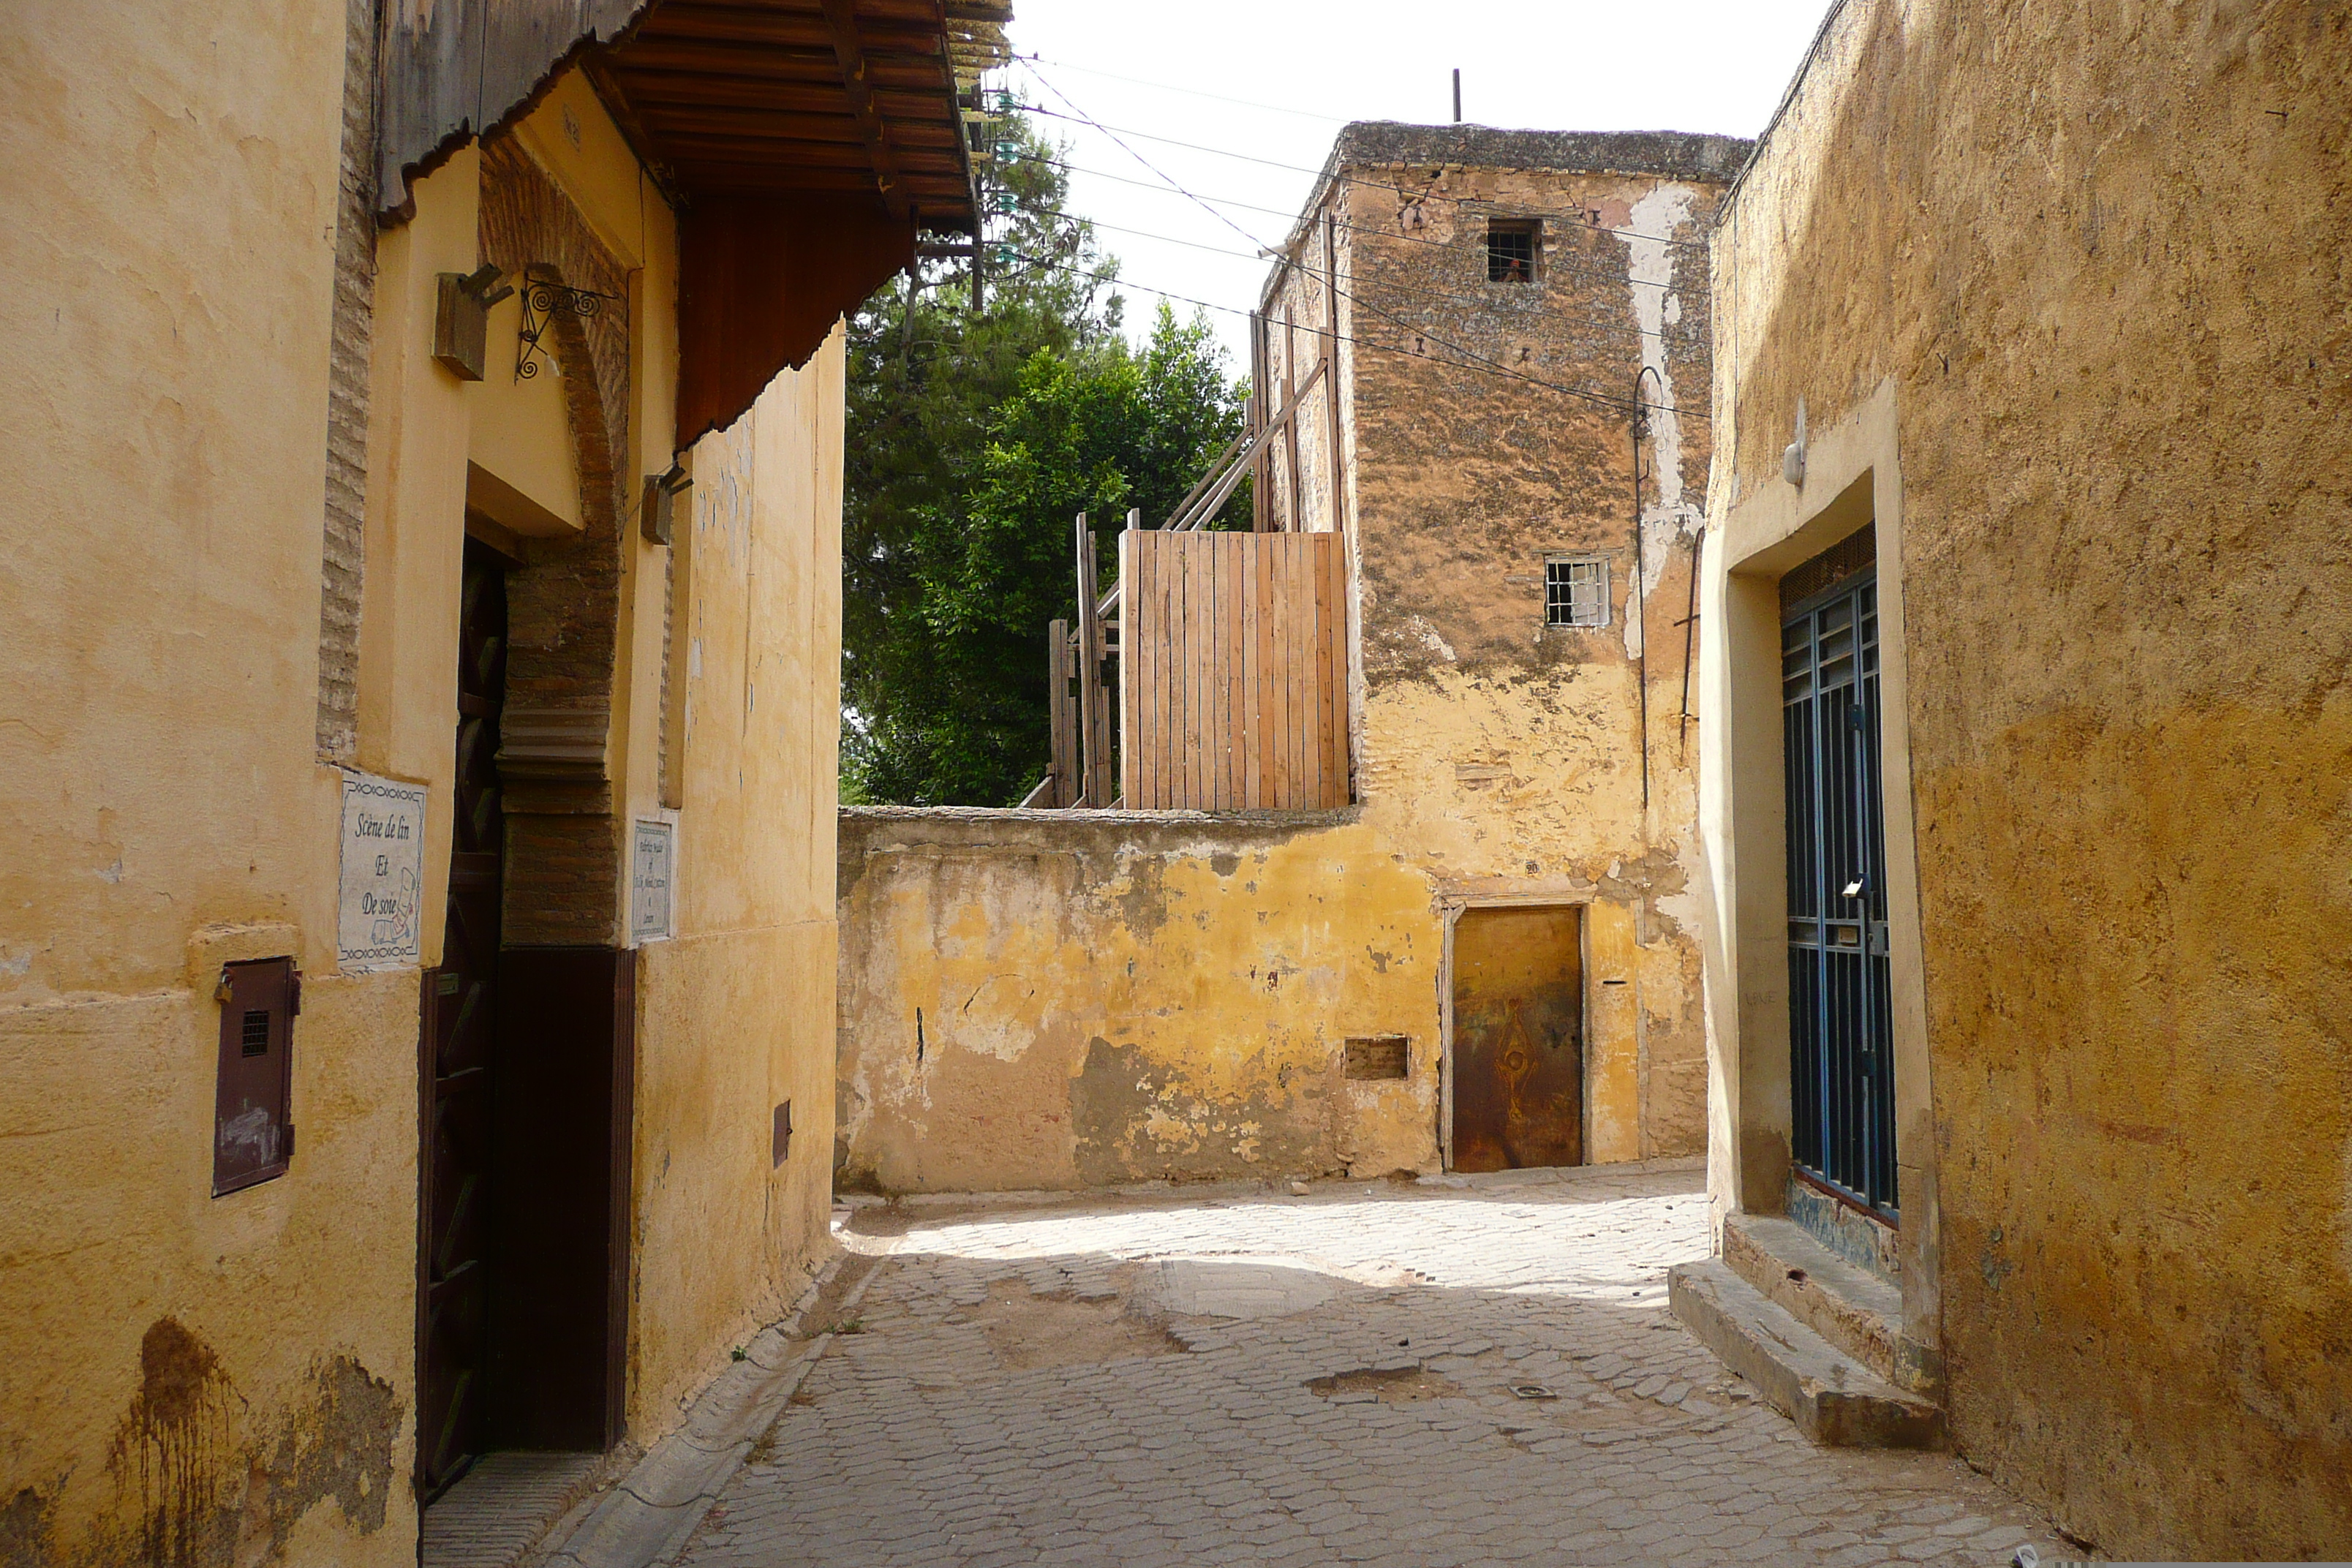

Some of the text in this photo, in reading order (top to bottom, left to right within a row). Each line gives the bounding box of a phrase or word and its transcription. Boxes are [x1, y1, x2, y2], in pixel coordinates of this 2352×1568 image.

[355, 813, 410, 840] Scène de lin
[375, 854, 389, 877] Et
[1526, 863, 1538, 874] 20
[362, 892, 398, 916] De soie
